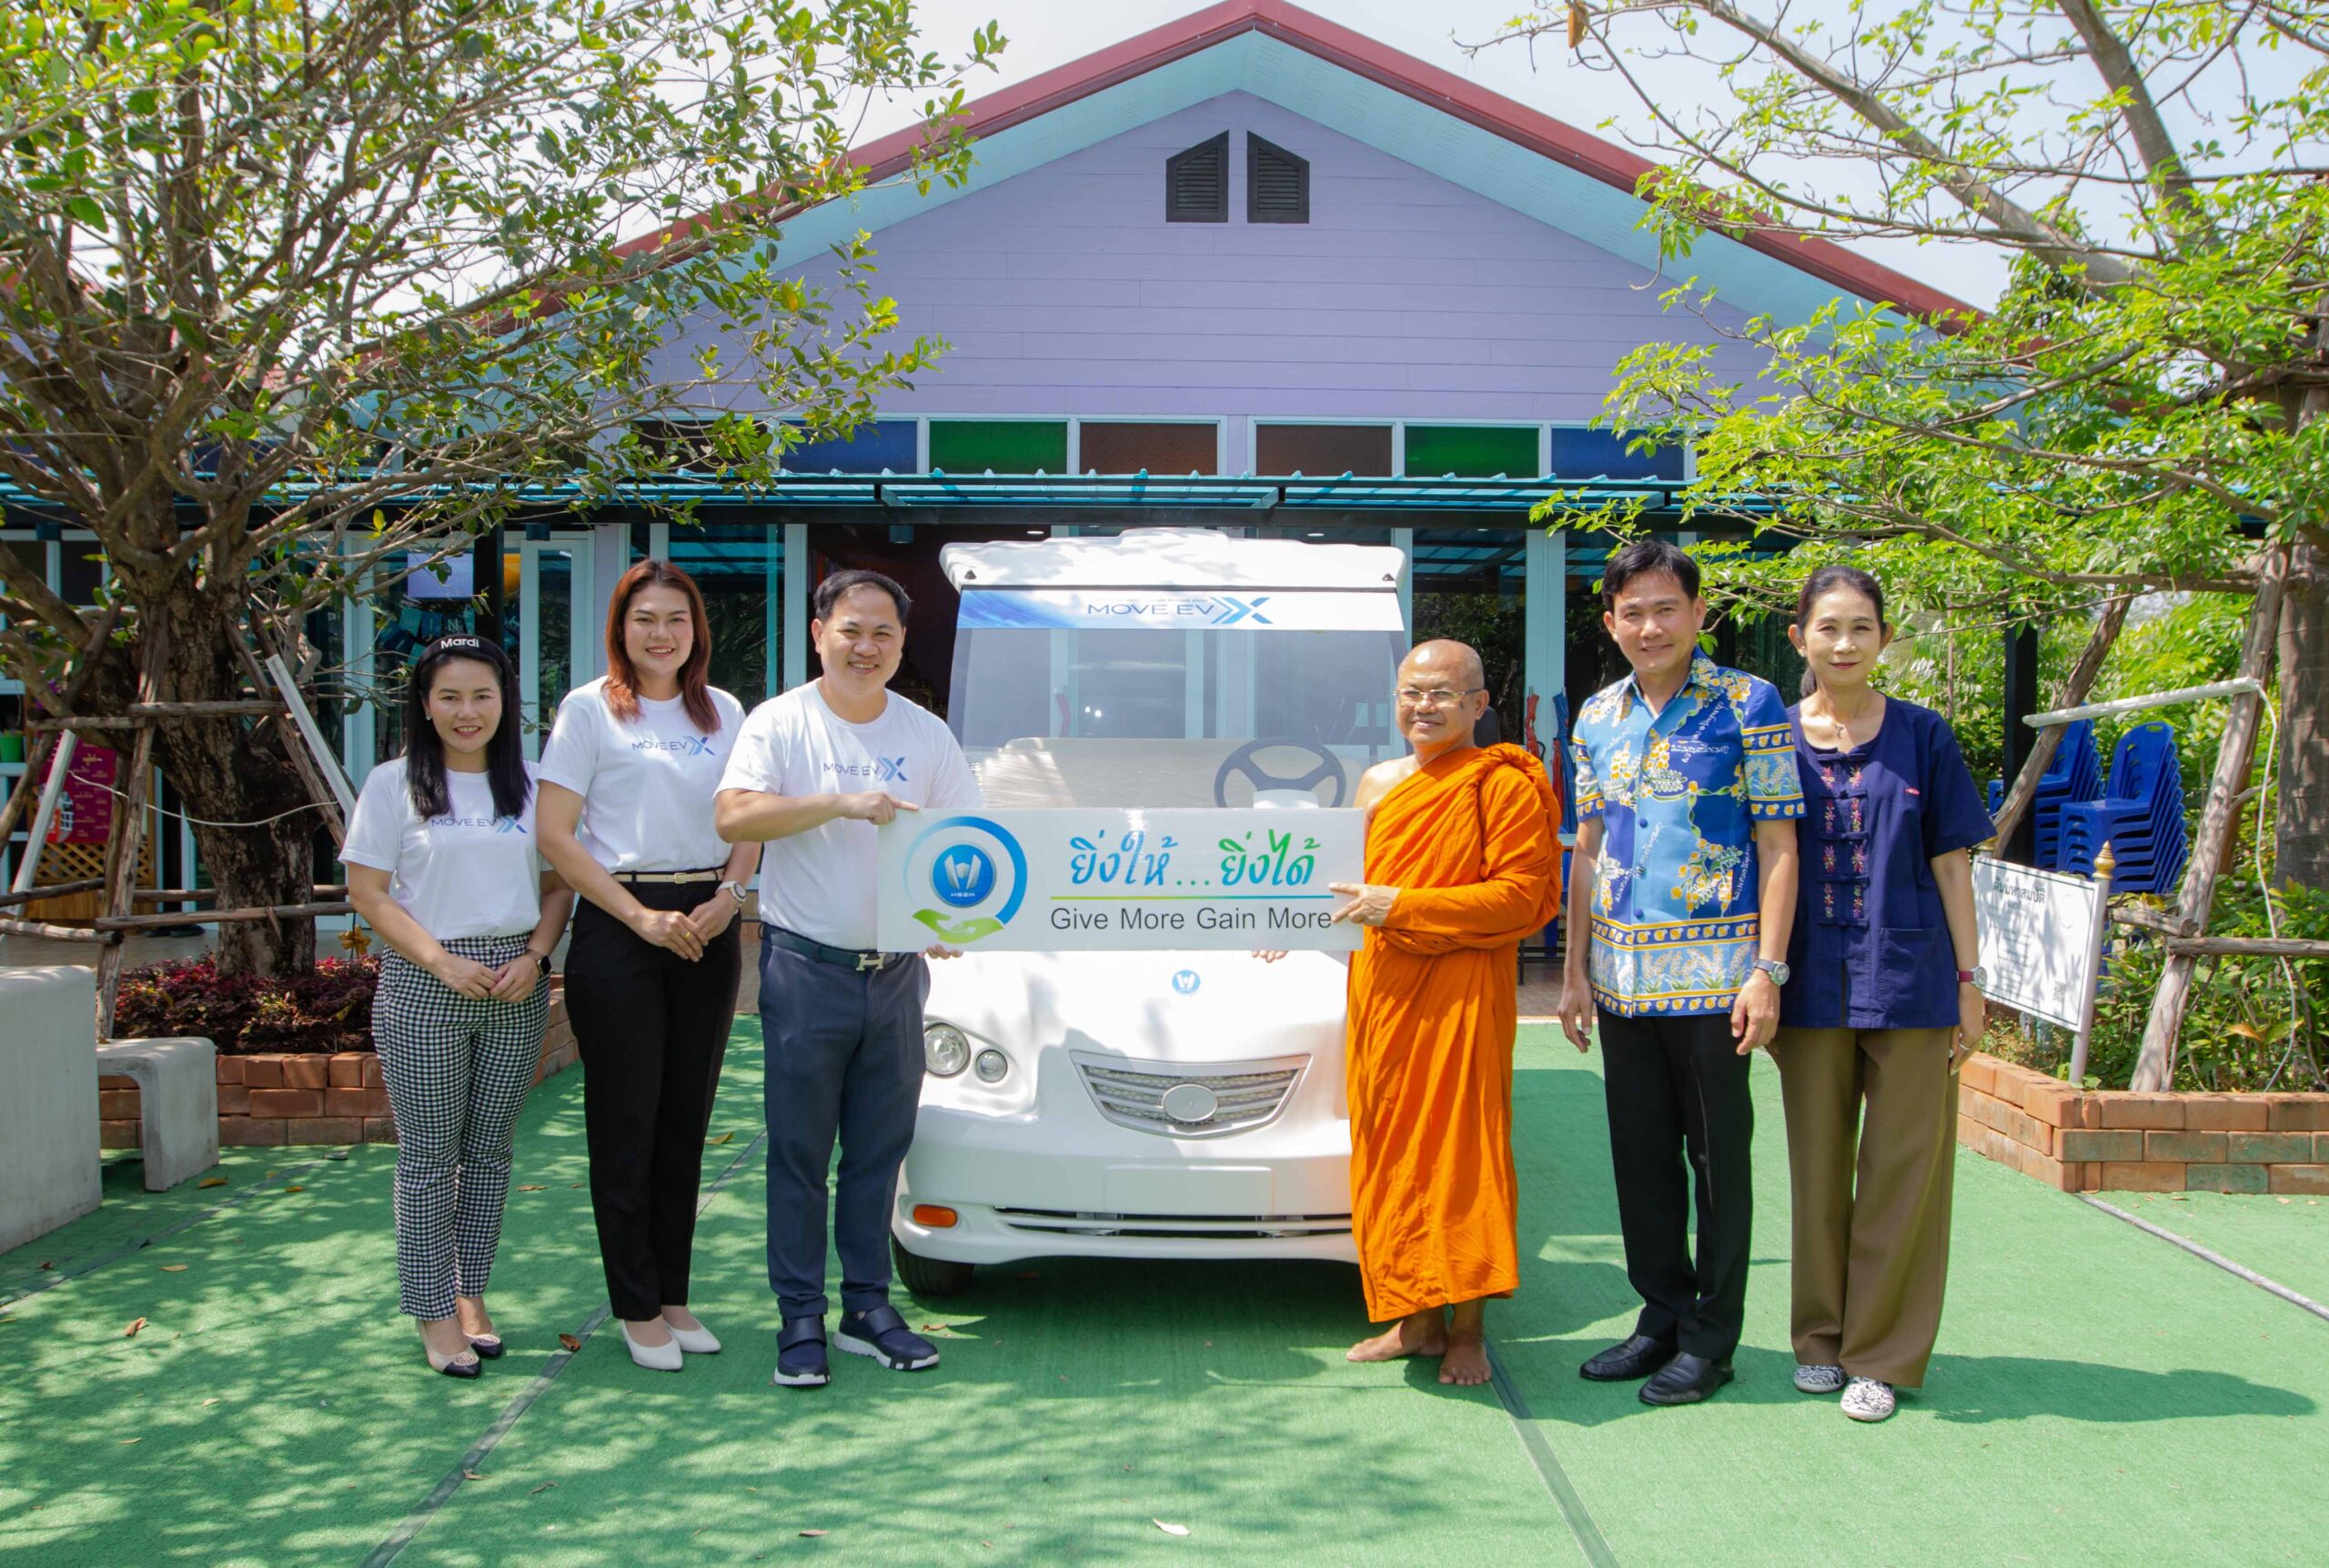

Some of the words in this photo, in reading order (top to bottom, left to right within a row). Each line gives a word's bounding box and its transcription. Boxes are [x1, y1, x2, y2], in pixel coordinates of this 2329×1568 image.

[1087, 604, 1169, 615] MOVE
[440, 638, 480, 649] Mardi
[631, 740, 668, 750] MOVE
[822, 762, 859, 777] MOVE
[431, 818, 474, 828] MOVE
[1050, 907, 1109, 930] Give
[1120, 907, 1185, 930] More
[1196, 907, 1255, 930] Gain
[1268, 907, 1332, 930] More
